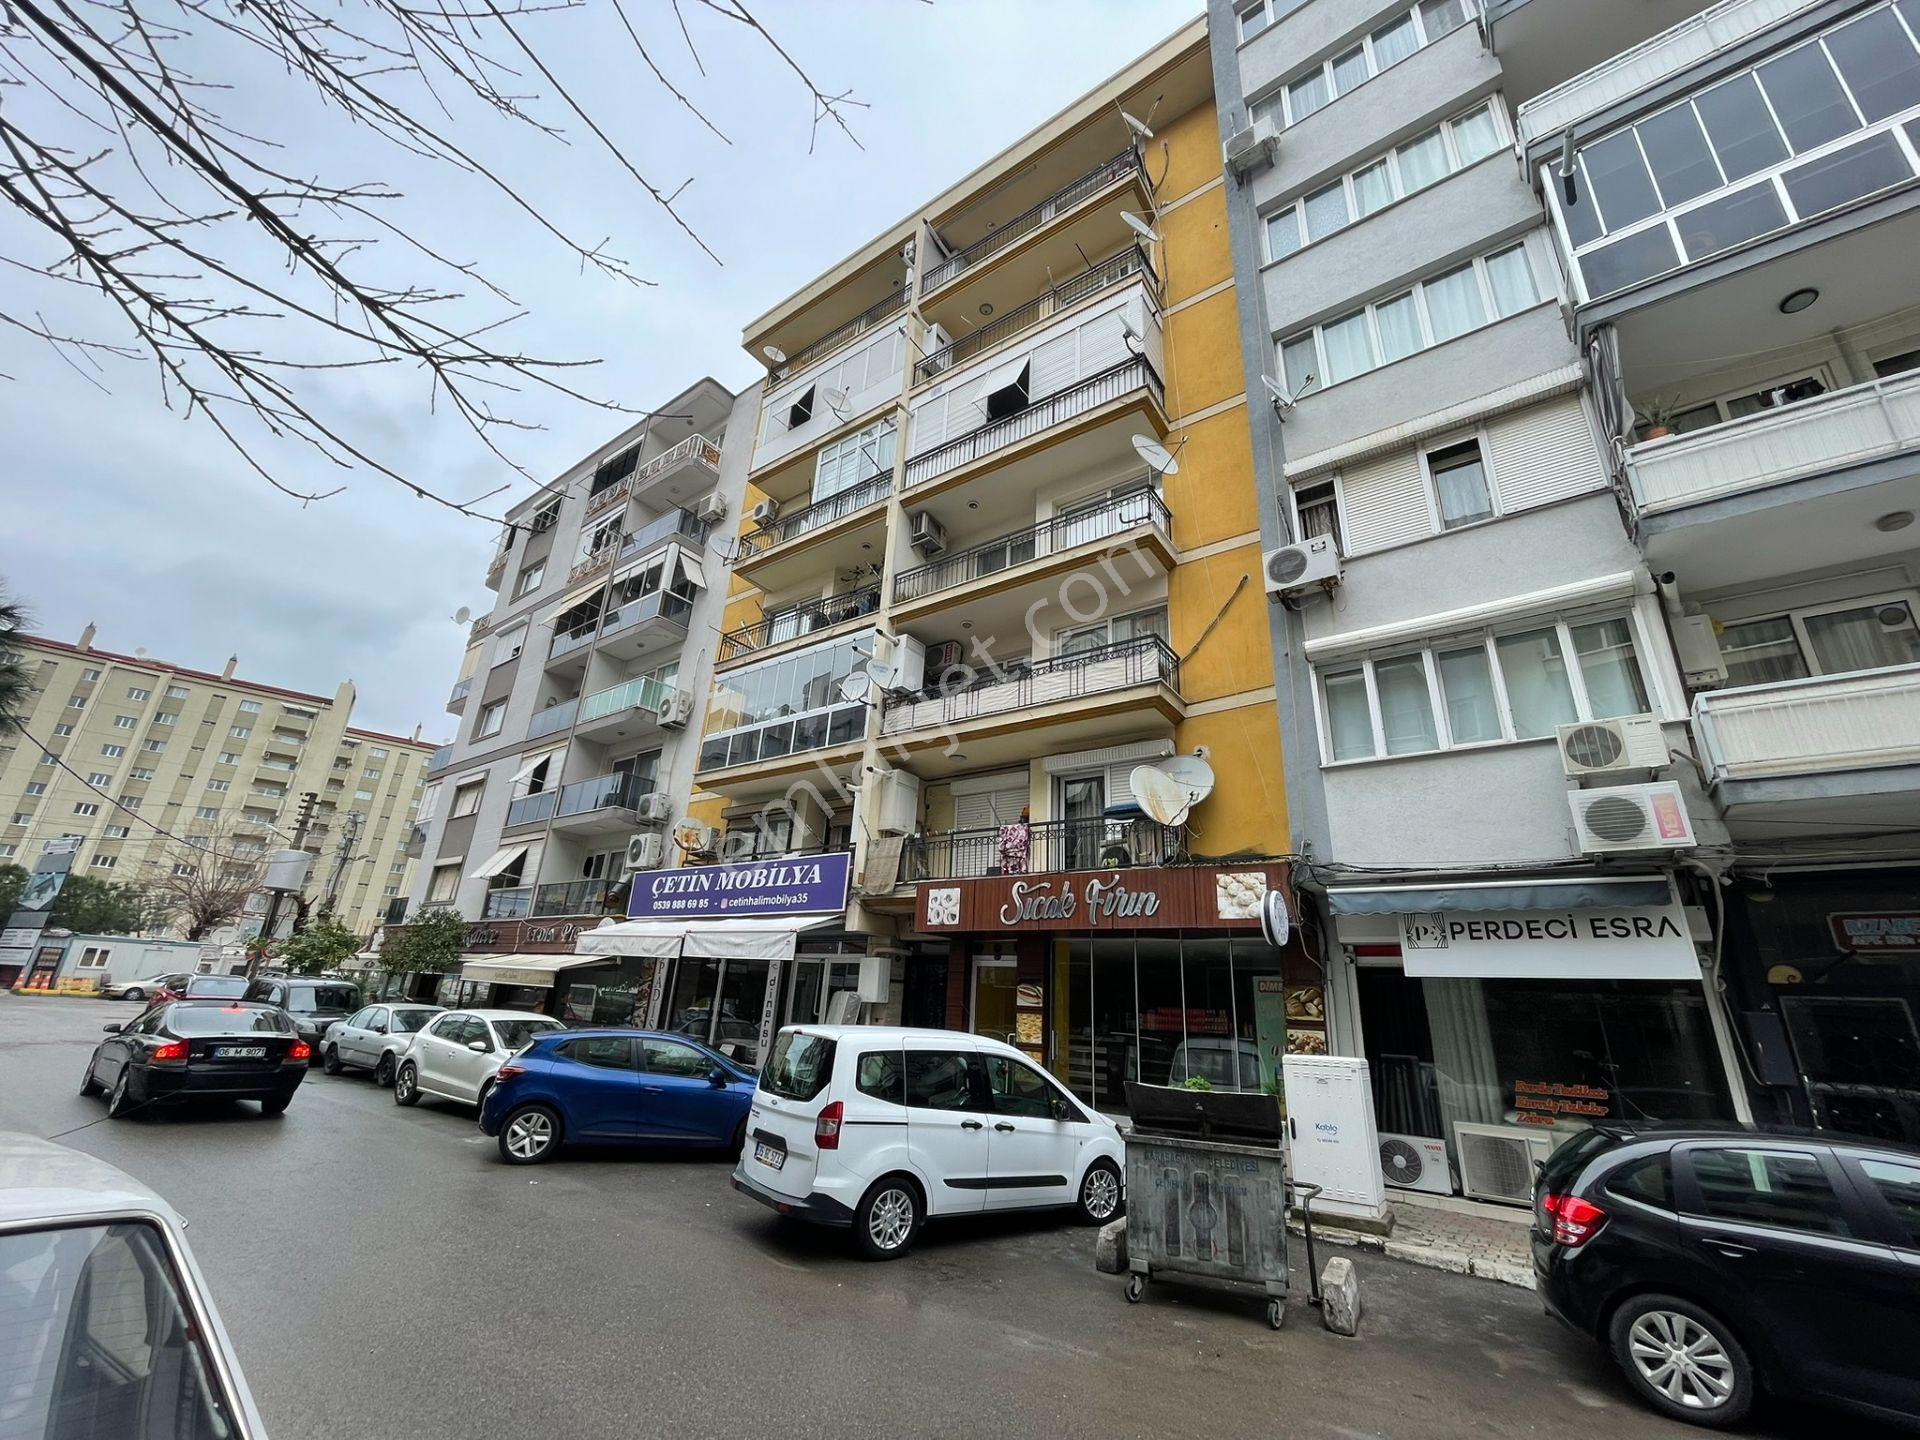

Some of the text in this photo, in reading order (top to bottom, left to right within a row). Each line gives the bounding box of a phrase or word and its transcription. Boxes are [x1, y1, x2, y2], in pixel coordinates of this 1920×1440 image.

[652, 862, 822, 898] ÇETİN MOBİLYA
[653, 892, 808, 910] 0539 888 69 85 cetinhalimobilya35
[1450, 913, 1578, 941] PERDECİ
[1589, 916, 1682, 939] ESRA
[761, 976, 777, 1048] dinarsu
